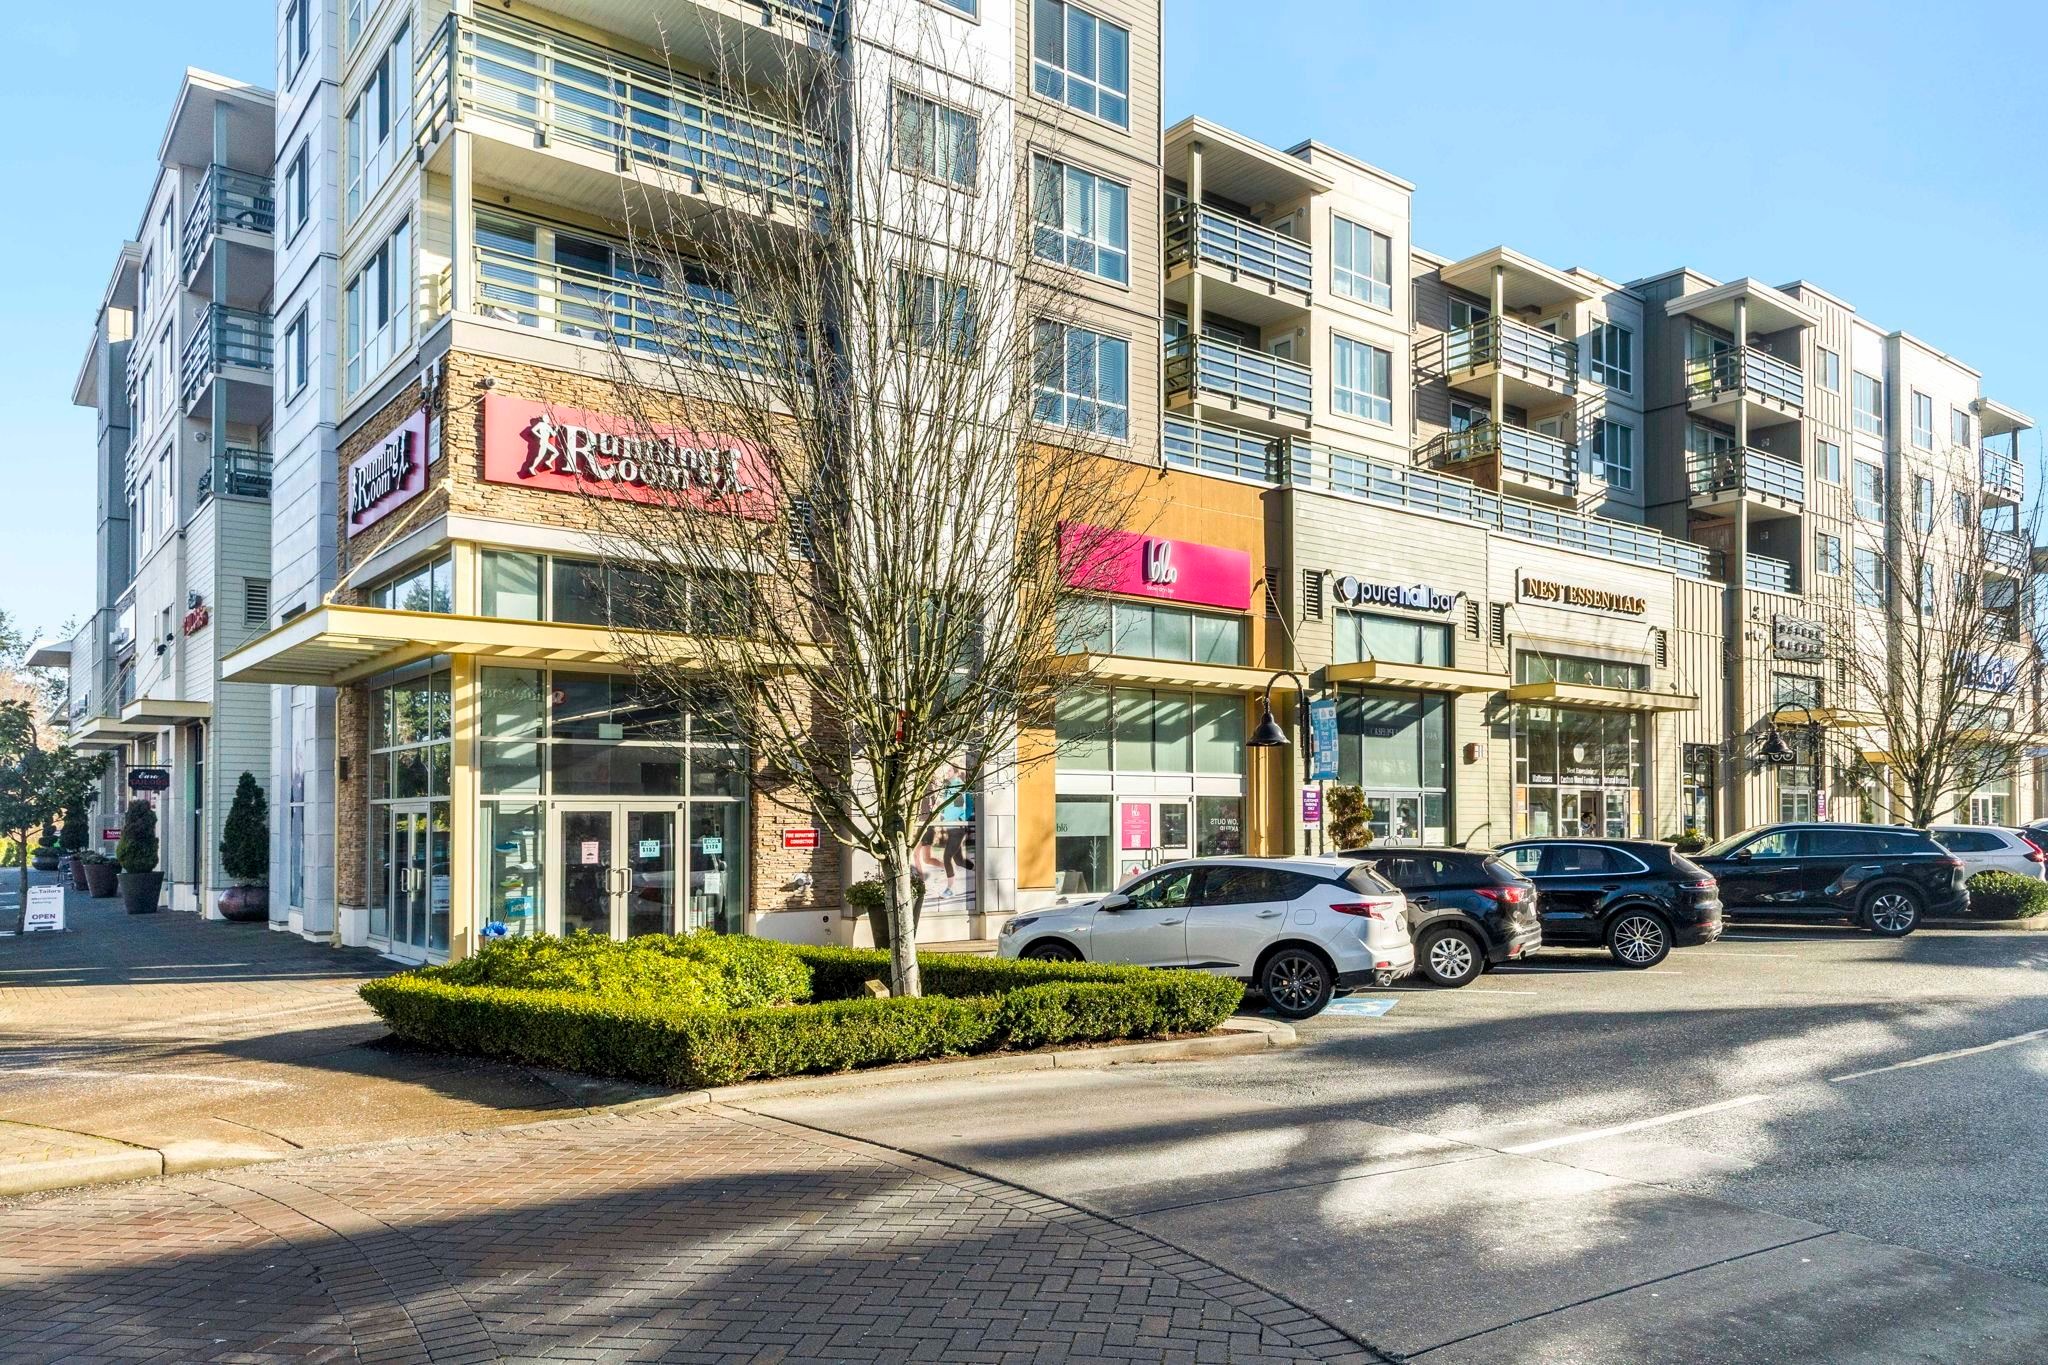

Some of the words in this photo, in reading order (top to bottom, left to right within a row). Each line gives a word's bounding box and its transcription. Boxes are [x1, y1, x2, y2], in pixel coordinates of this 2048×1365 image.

[357, 441, 400, 510] Running
[562, 423, 722, 485] Running
[1148, 537, 1178, 584] blo
[1528, 578, 1565, 600] NEST
[1570, 586, 1647, 613] ESSENTIALS
